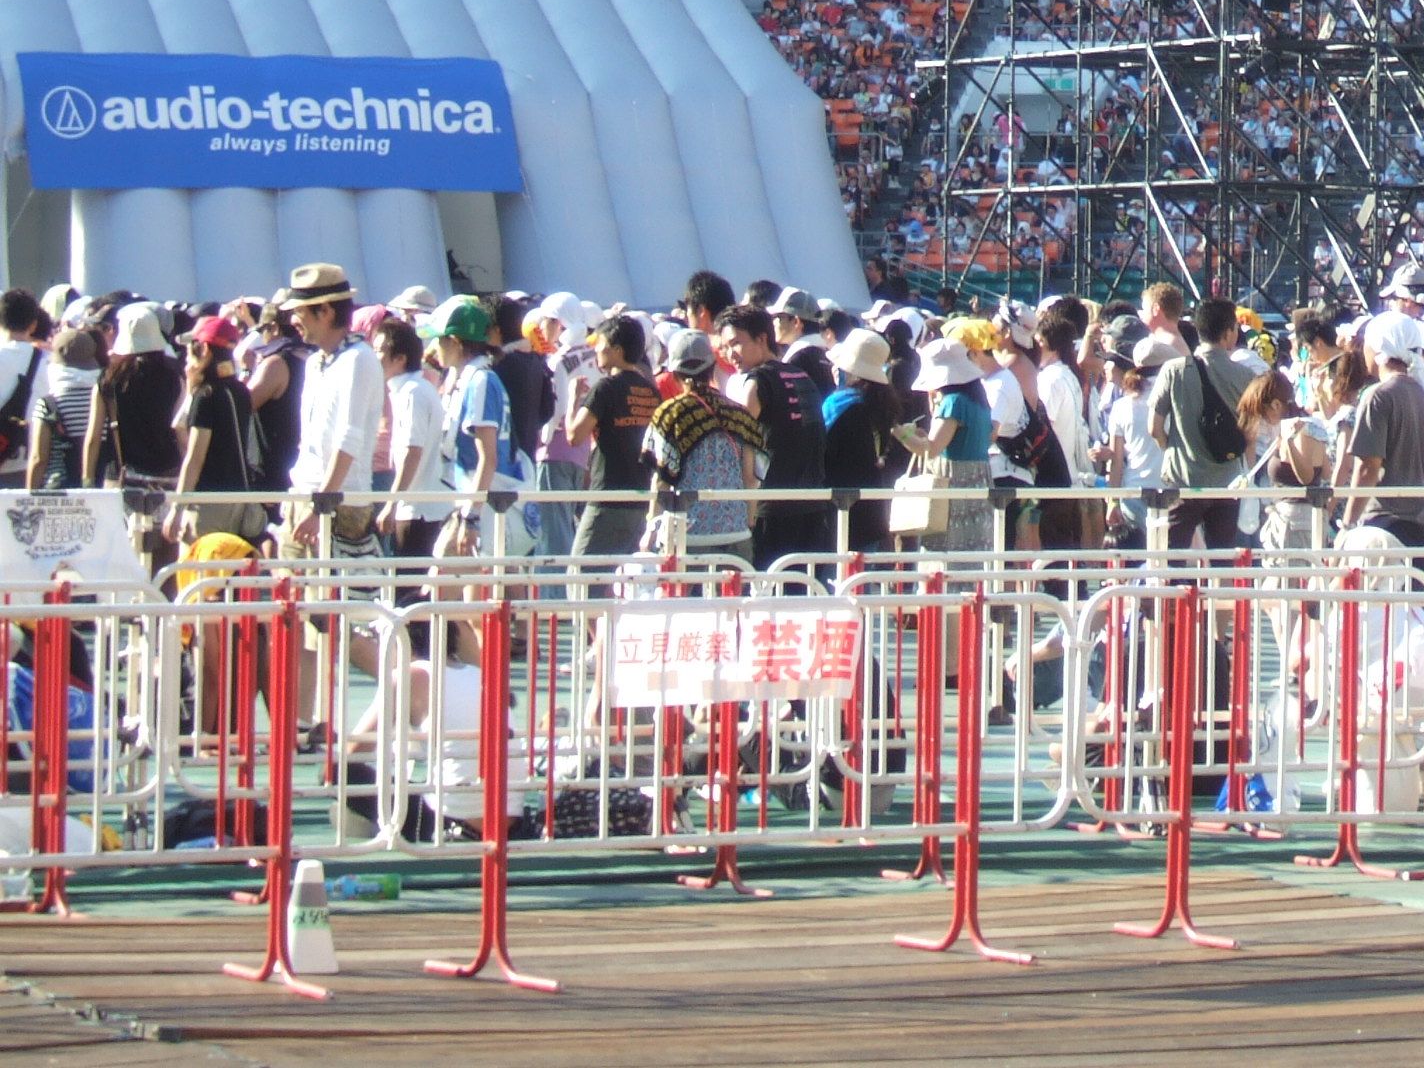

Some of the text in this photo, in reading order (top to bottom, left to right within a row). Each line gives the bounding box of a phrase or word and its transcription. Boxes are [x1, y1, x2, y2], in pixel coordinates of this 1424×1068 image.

[102, 85, 495, 134] audio-technica
[209, 132, 391, 155] always listening
[751, 619, 860, 684] 禁煙
